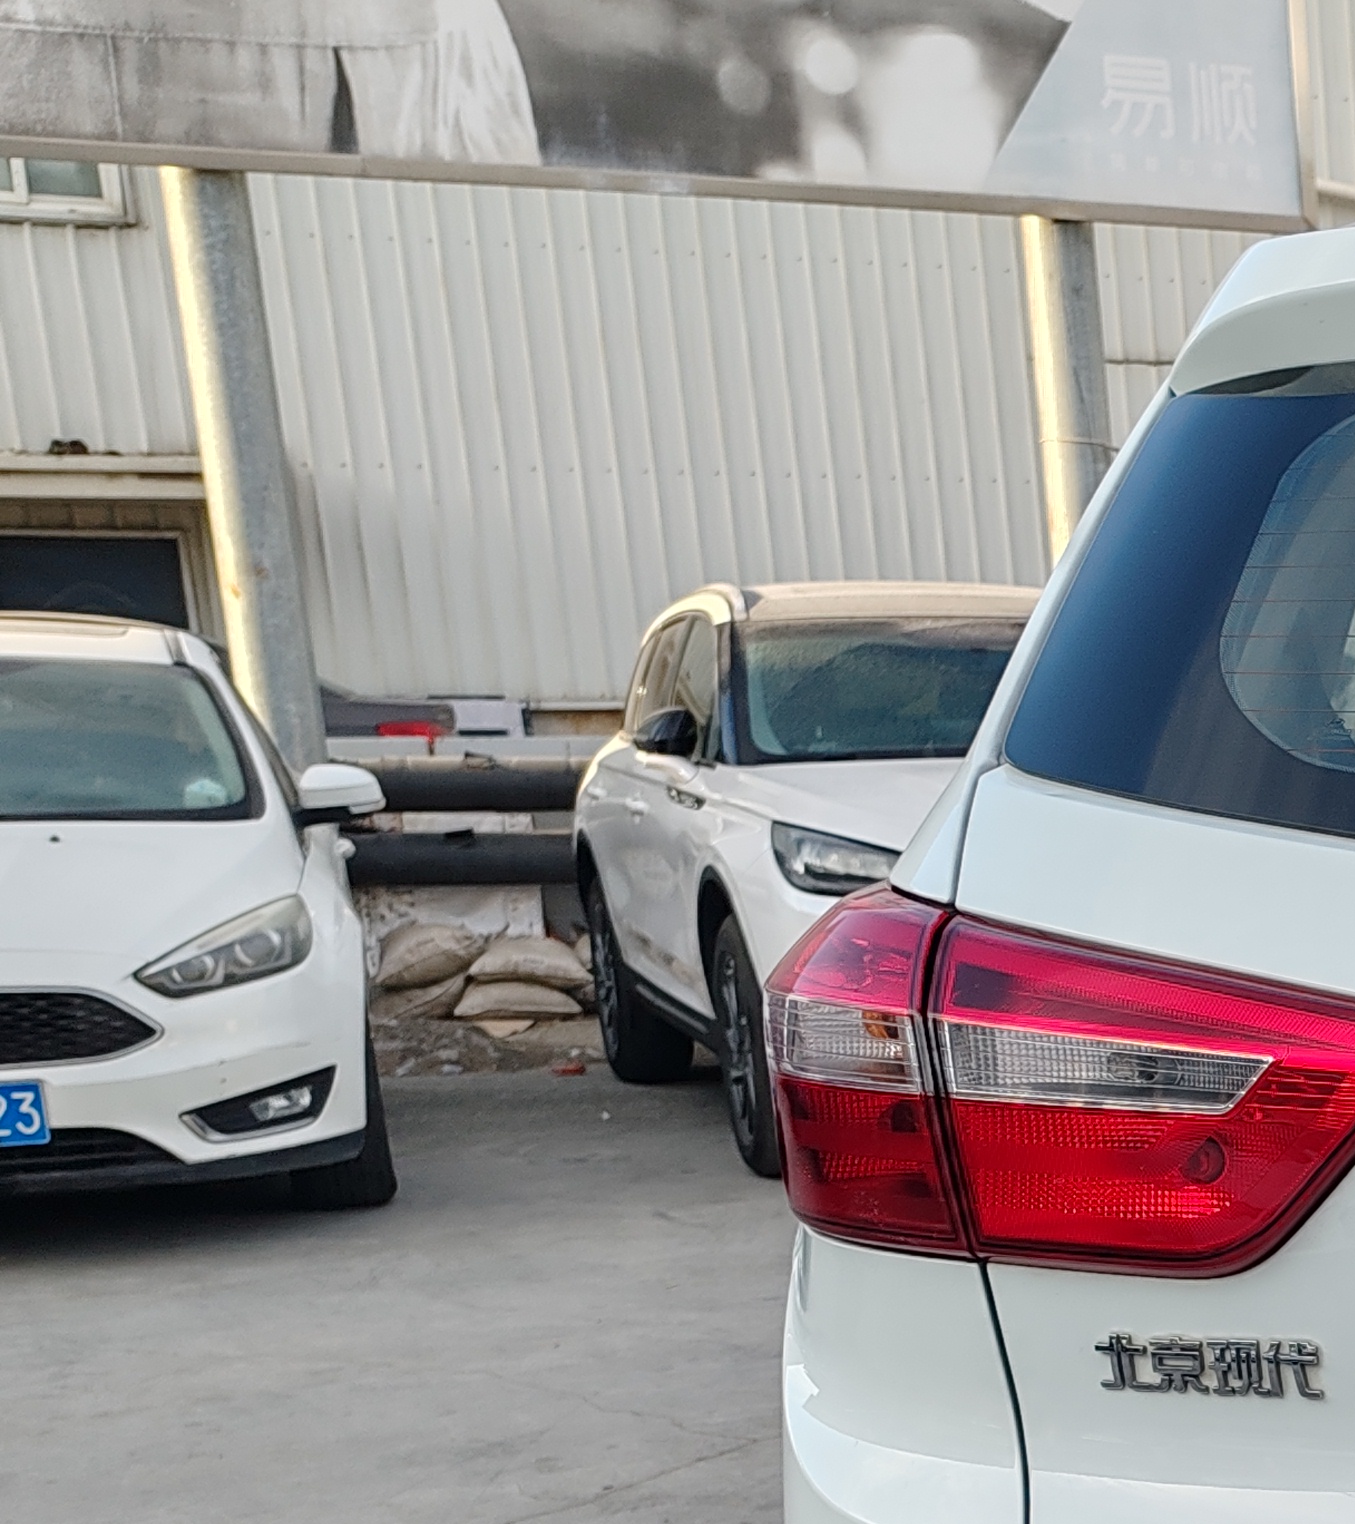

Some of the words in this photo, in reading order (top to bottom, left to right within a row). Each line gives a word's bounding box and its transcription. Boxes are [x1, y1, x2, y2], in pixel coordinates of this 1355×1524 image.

[1101, 55, 1257, 145] 易顺
[1095, 1333, 1324, 1399] 北京现代
